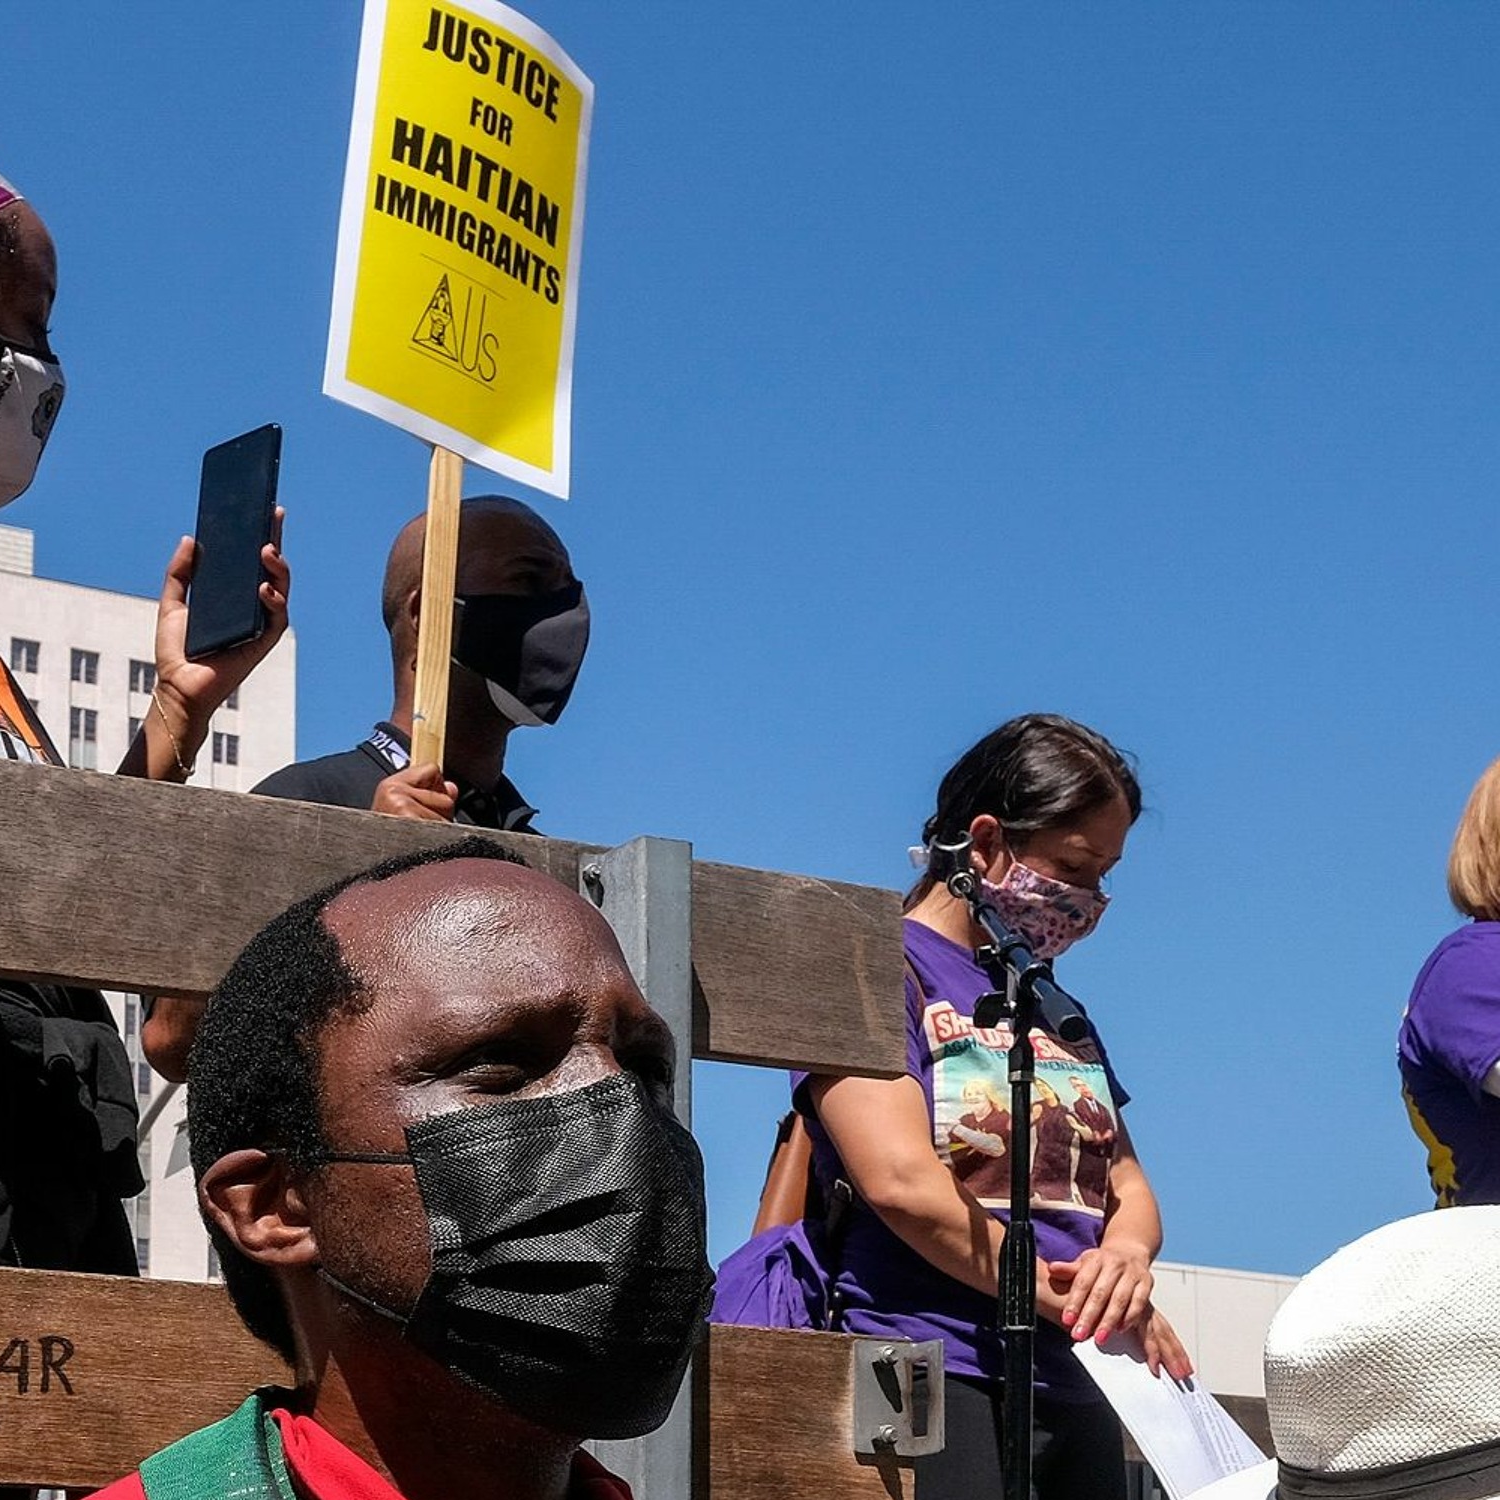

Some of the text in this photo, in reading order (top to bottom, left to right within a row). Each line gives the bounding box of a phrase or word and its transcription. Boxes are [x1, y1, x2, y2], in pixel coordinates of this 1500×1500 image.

[422, 8, 561, 123] JUSTICE
[469, 97, 513, 146] FOR
[373, 174, 561, 305] IMMIGRANTS
[390, 118, 560, 249] HAITIAN
